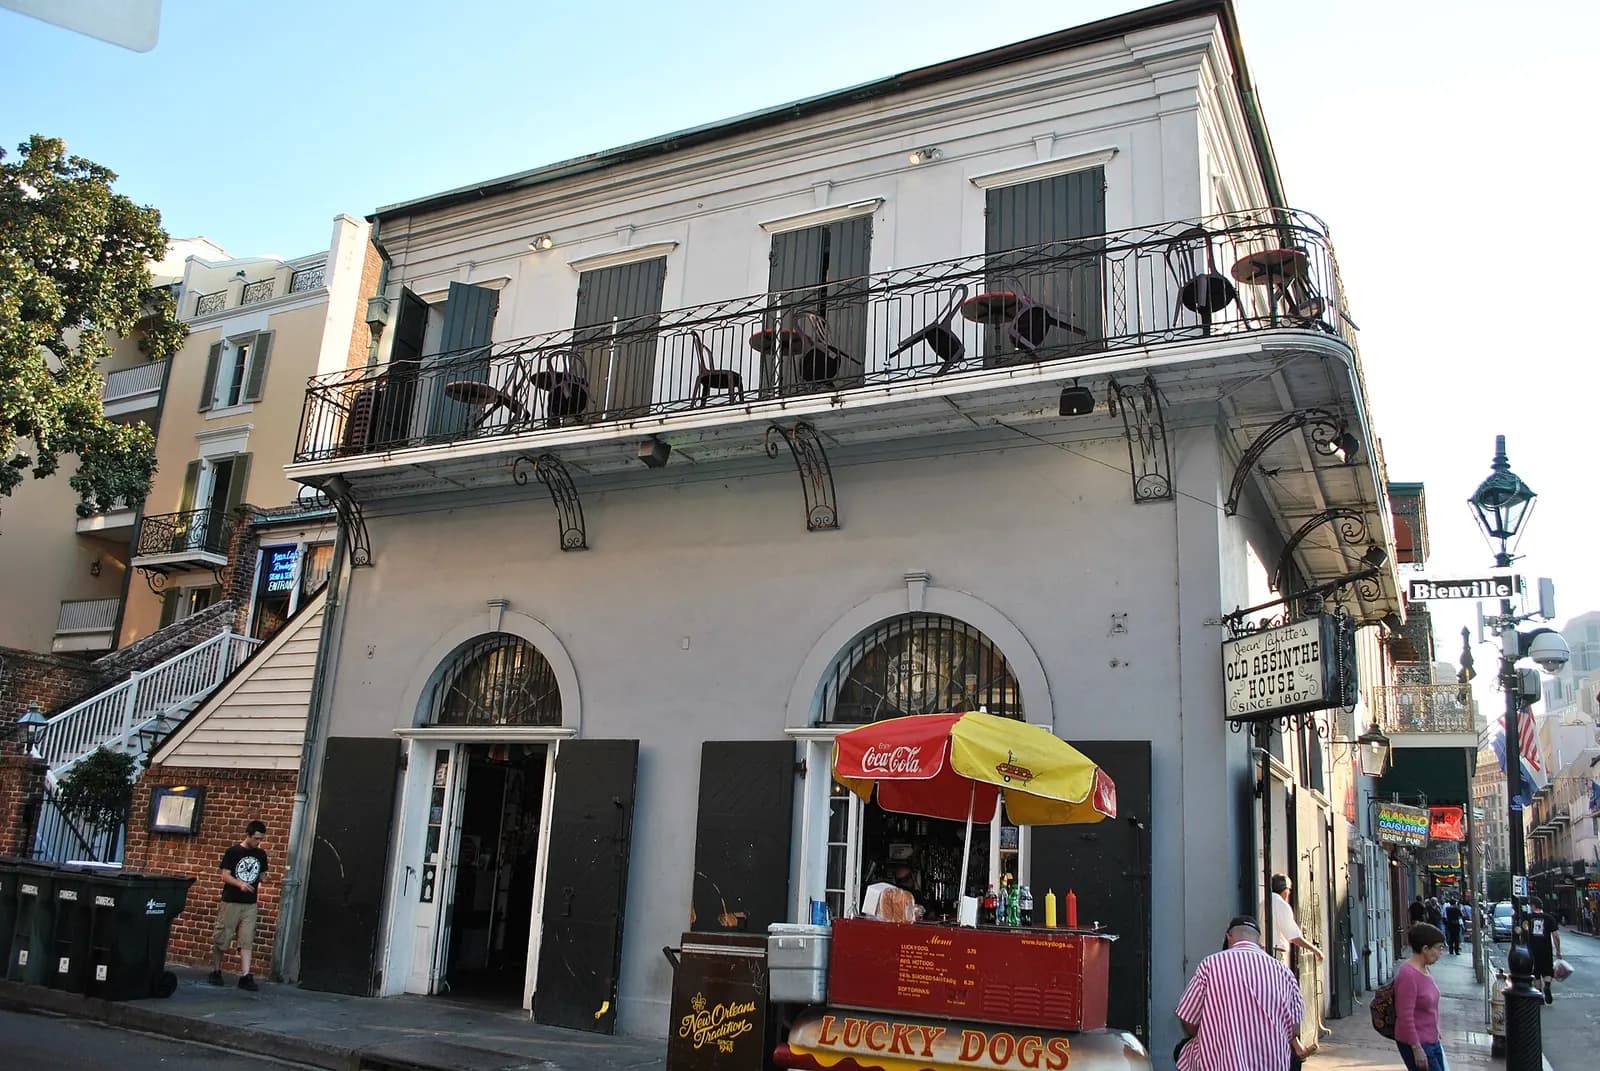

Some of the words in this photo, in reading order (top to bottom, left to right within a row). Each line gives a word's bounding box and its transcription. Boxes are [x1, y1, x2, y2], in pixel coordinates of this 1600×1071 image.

[268, 581, 294, 592] ENTRAN
[1413, 581, 1509, 599] Bienville
[1260, 627, 1309, 654] Lafitte's
[1227, 659, 1248, 682] OLD
[1253, 641, 1319, 676] ABSINTHE
[1248, 671, 1295, 699] HOUSE
[1238, 698, 1273, 713] SINCE
[1279, 690, 1309, 704] 1807
[1382, 833, 1403, 843] BREW
[926, 935, 952, 946] Menu
[679, 1010, 711, 1037] New
[712, 1001, 756, 1026] Orleans
[694, 1019, 753, 1048] Tradition
[818, 1015, 946, 1057] LUCKY
[959, 1030, 1070, 1071] DOGS
